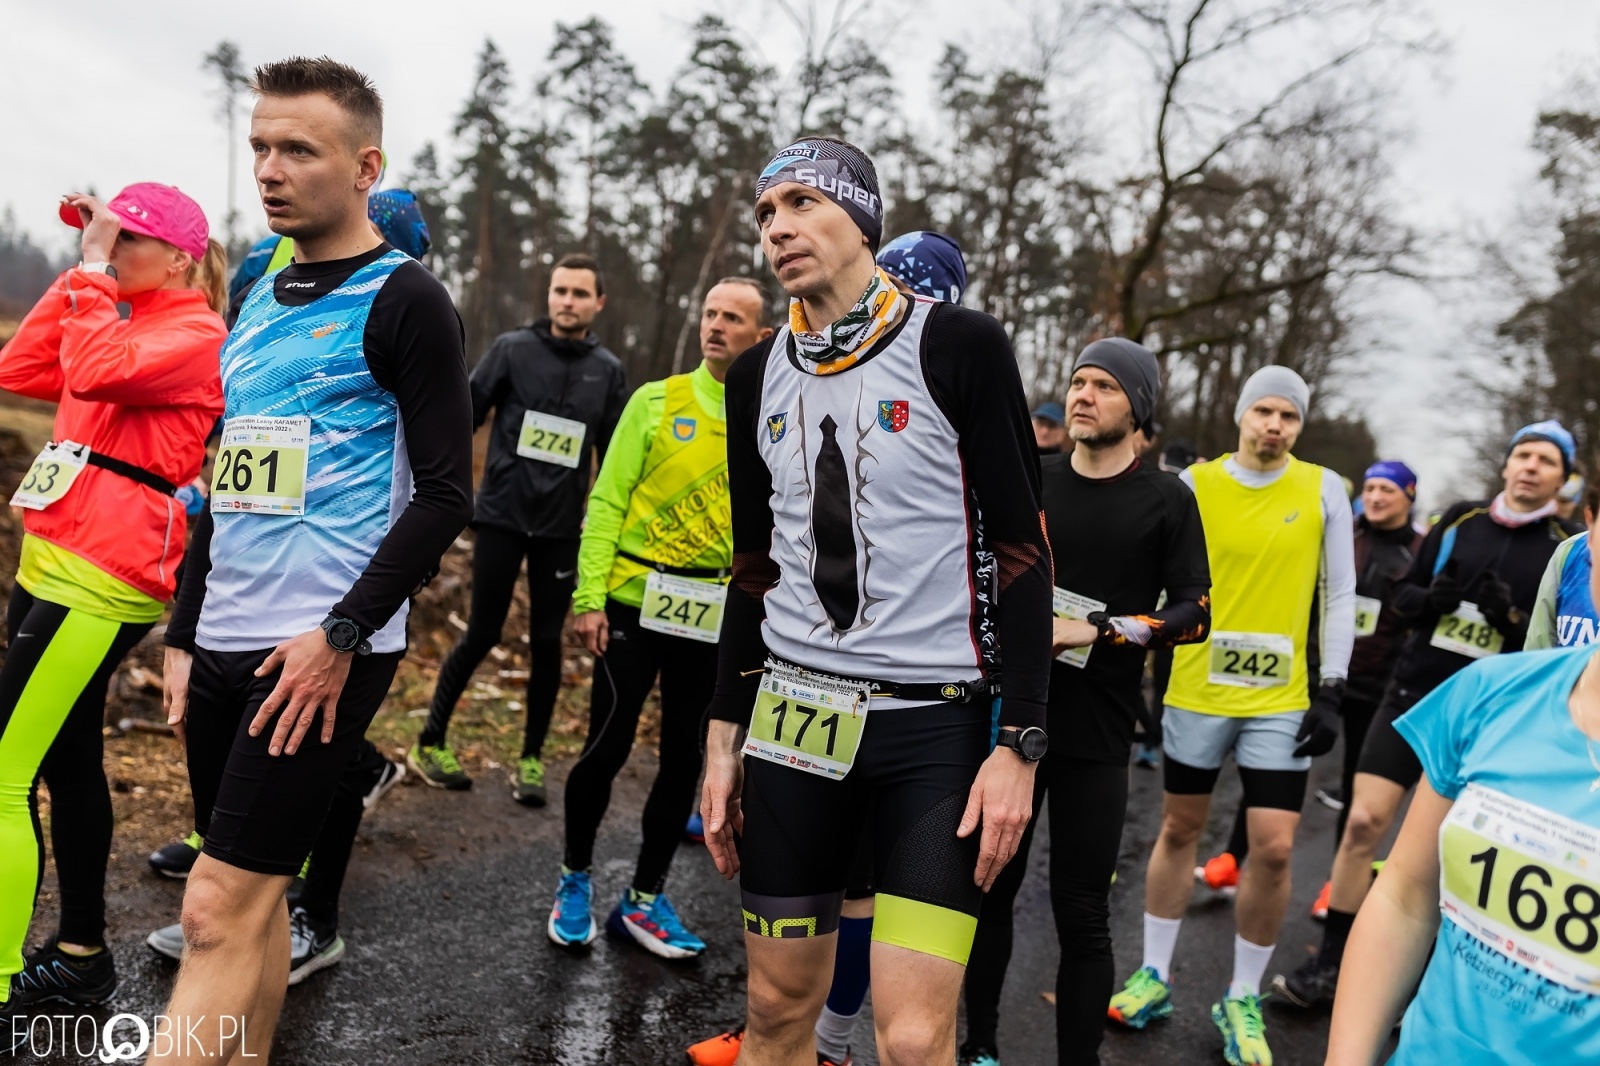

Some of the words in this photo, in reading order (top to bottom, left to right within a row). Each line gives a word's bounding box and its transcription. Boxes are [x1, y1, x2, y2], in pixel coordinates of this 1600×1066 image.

[795, 168, 878, 209] Super
[530, 429, 572, 455] 274
[215, 448, 279, 493] 261
[655, 594, 711, 627] 247
[1444, 617, 1493, 649] 248
[1223, 650, 1279, 677] 242
[771, 700, 840, 757] 171
[1470, 846, 1600, 954] 168
